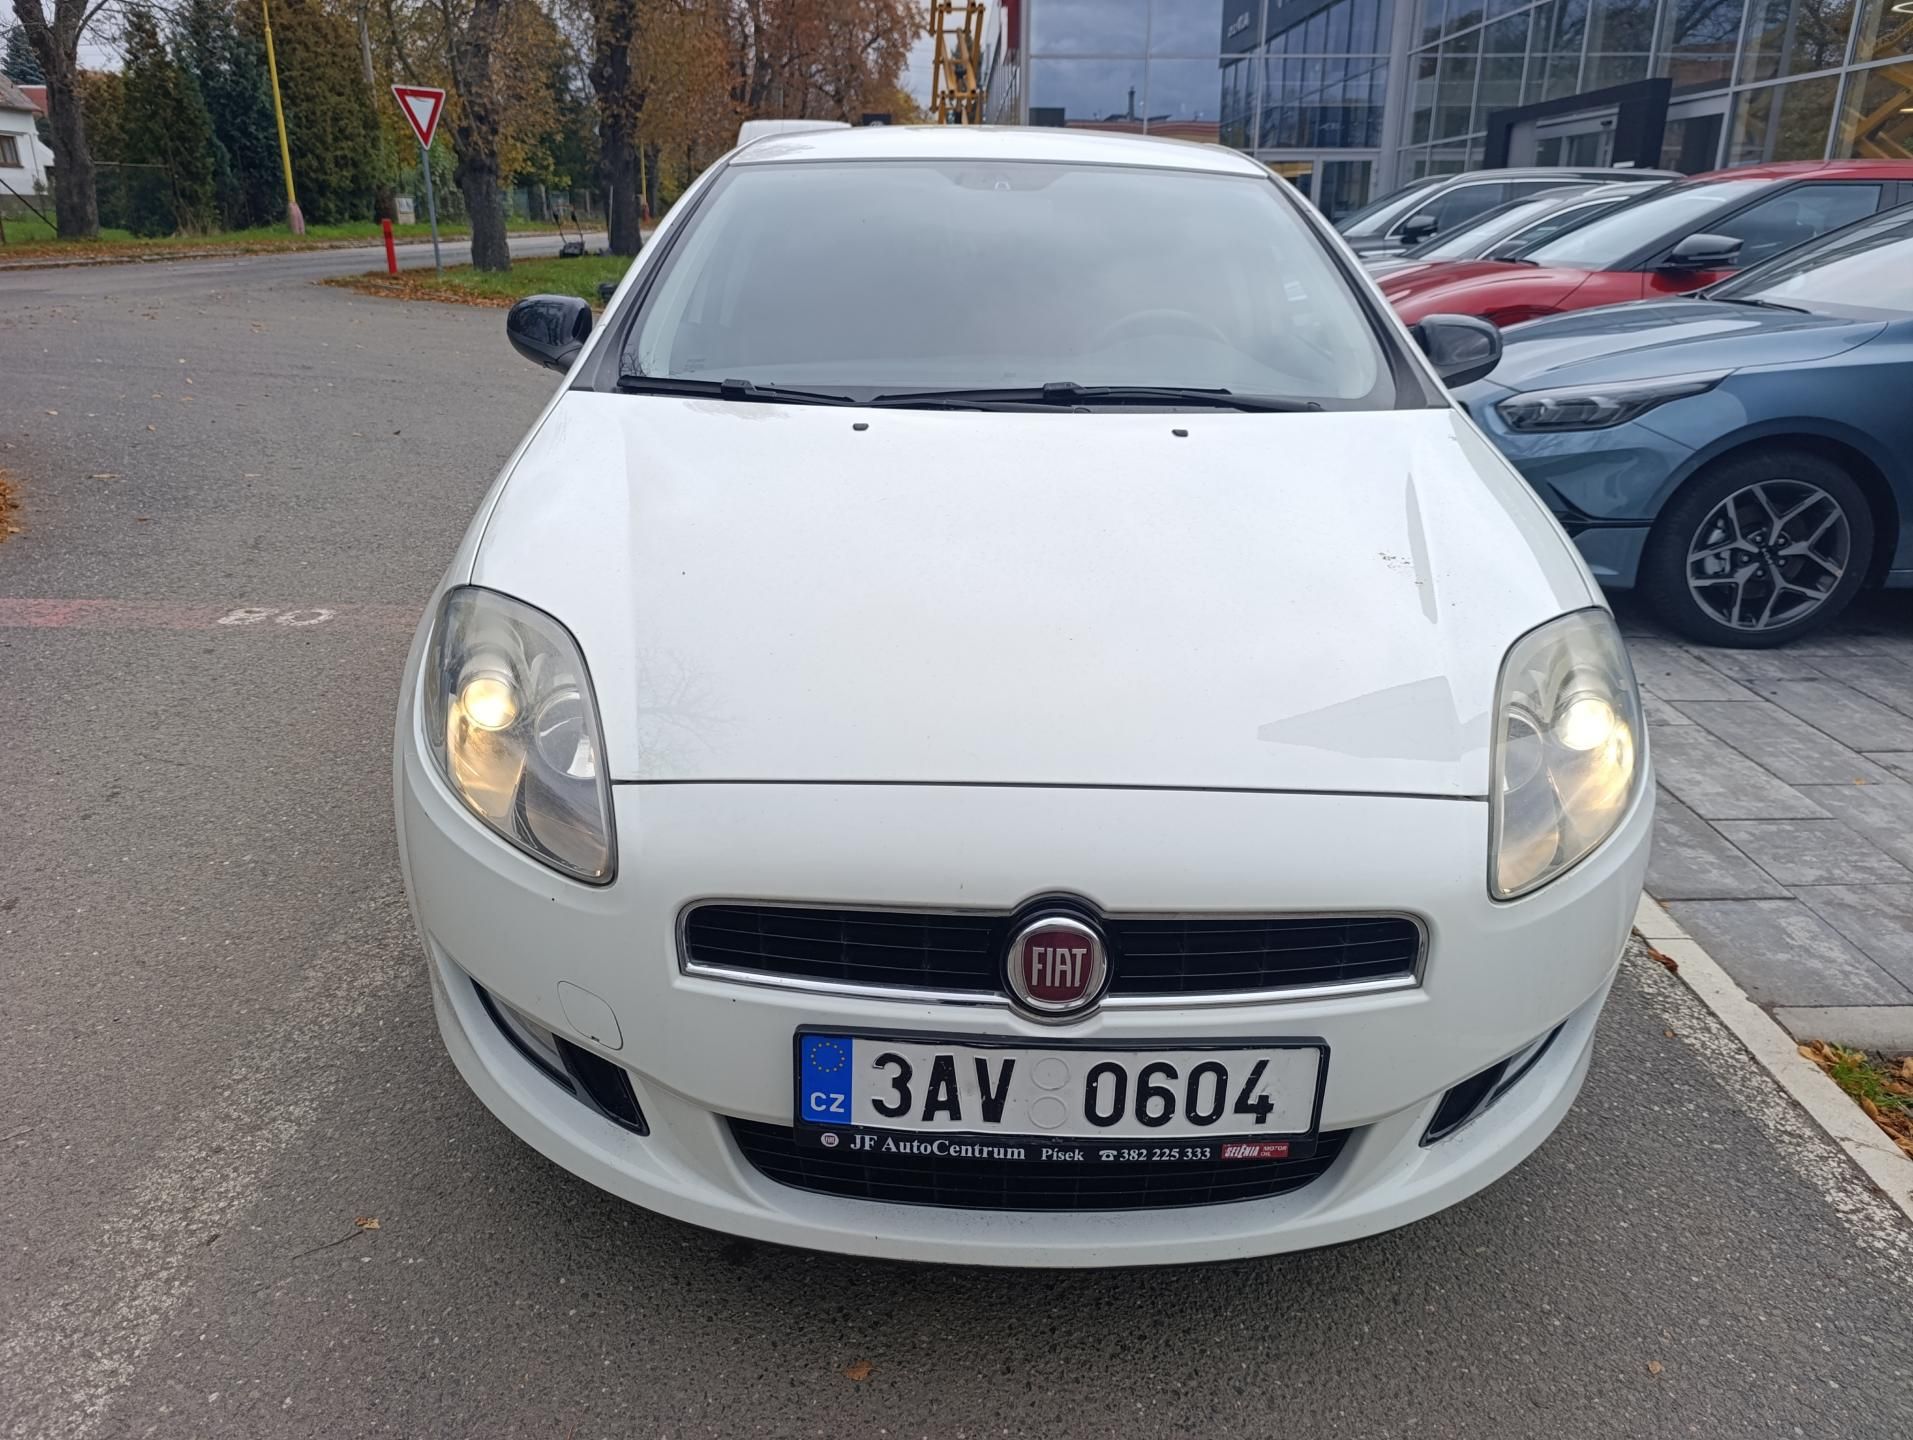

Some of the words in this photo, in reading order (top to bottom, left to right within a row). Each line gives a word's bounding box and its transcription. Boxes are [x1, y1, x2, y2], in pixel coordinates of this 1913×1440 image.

[1031, 946, 1088, 988] FIAT
[810, 1091, 845, 1113] CZ
[871, 1052, 1016, 1124] 3AV
[1084, 1058, 1275, 1128] 0604
[850, 1134, 878, 1151] JF
[881, 1136, 1026, 1160] AutoCentrum
[1041, 1147, 1085, 1161] Písek
[1119, 1148, 1148, 1161] 382
[1151, 1148, 1180, 1161] 225
[1183, 1147, 1211, 1160] 333
